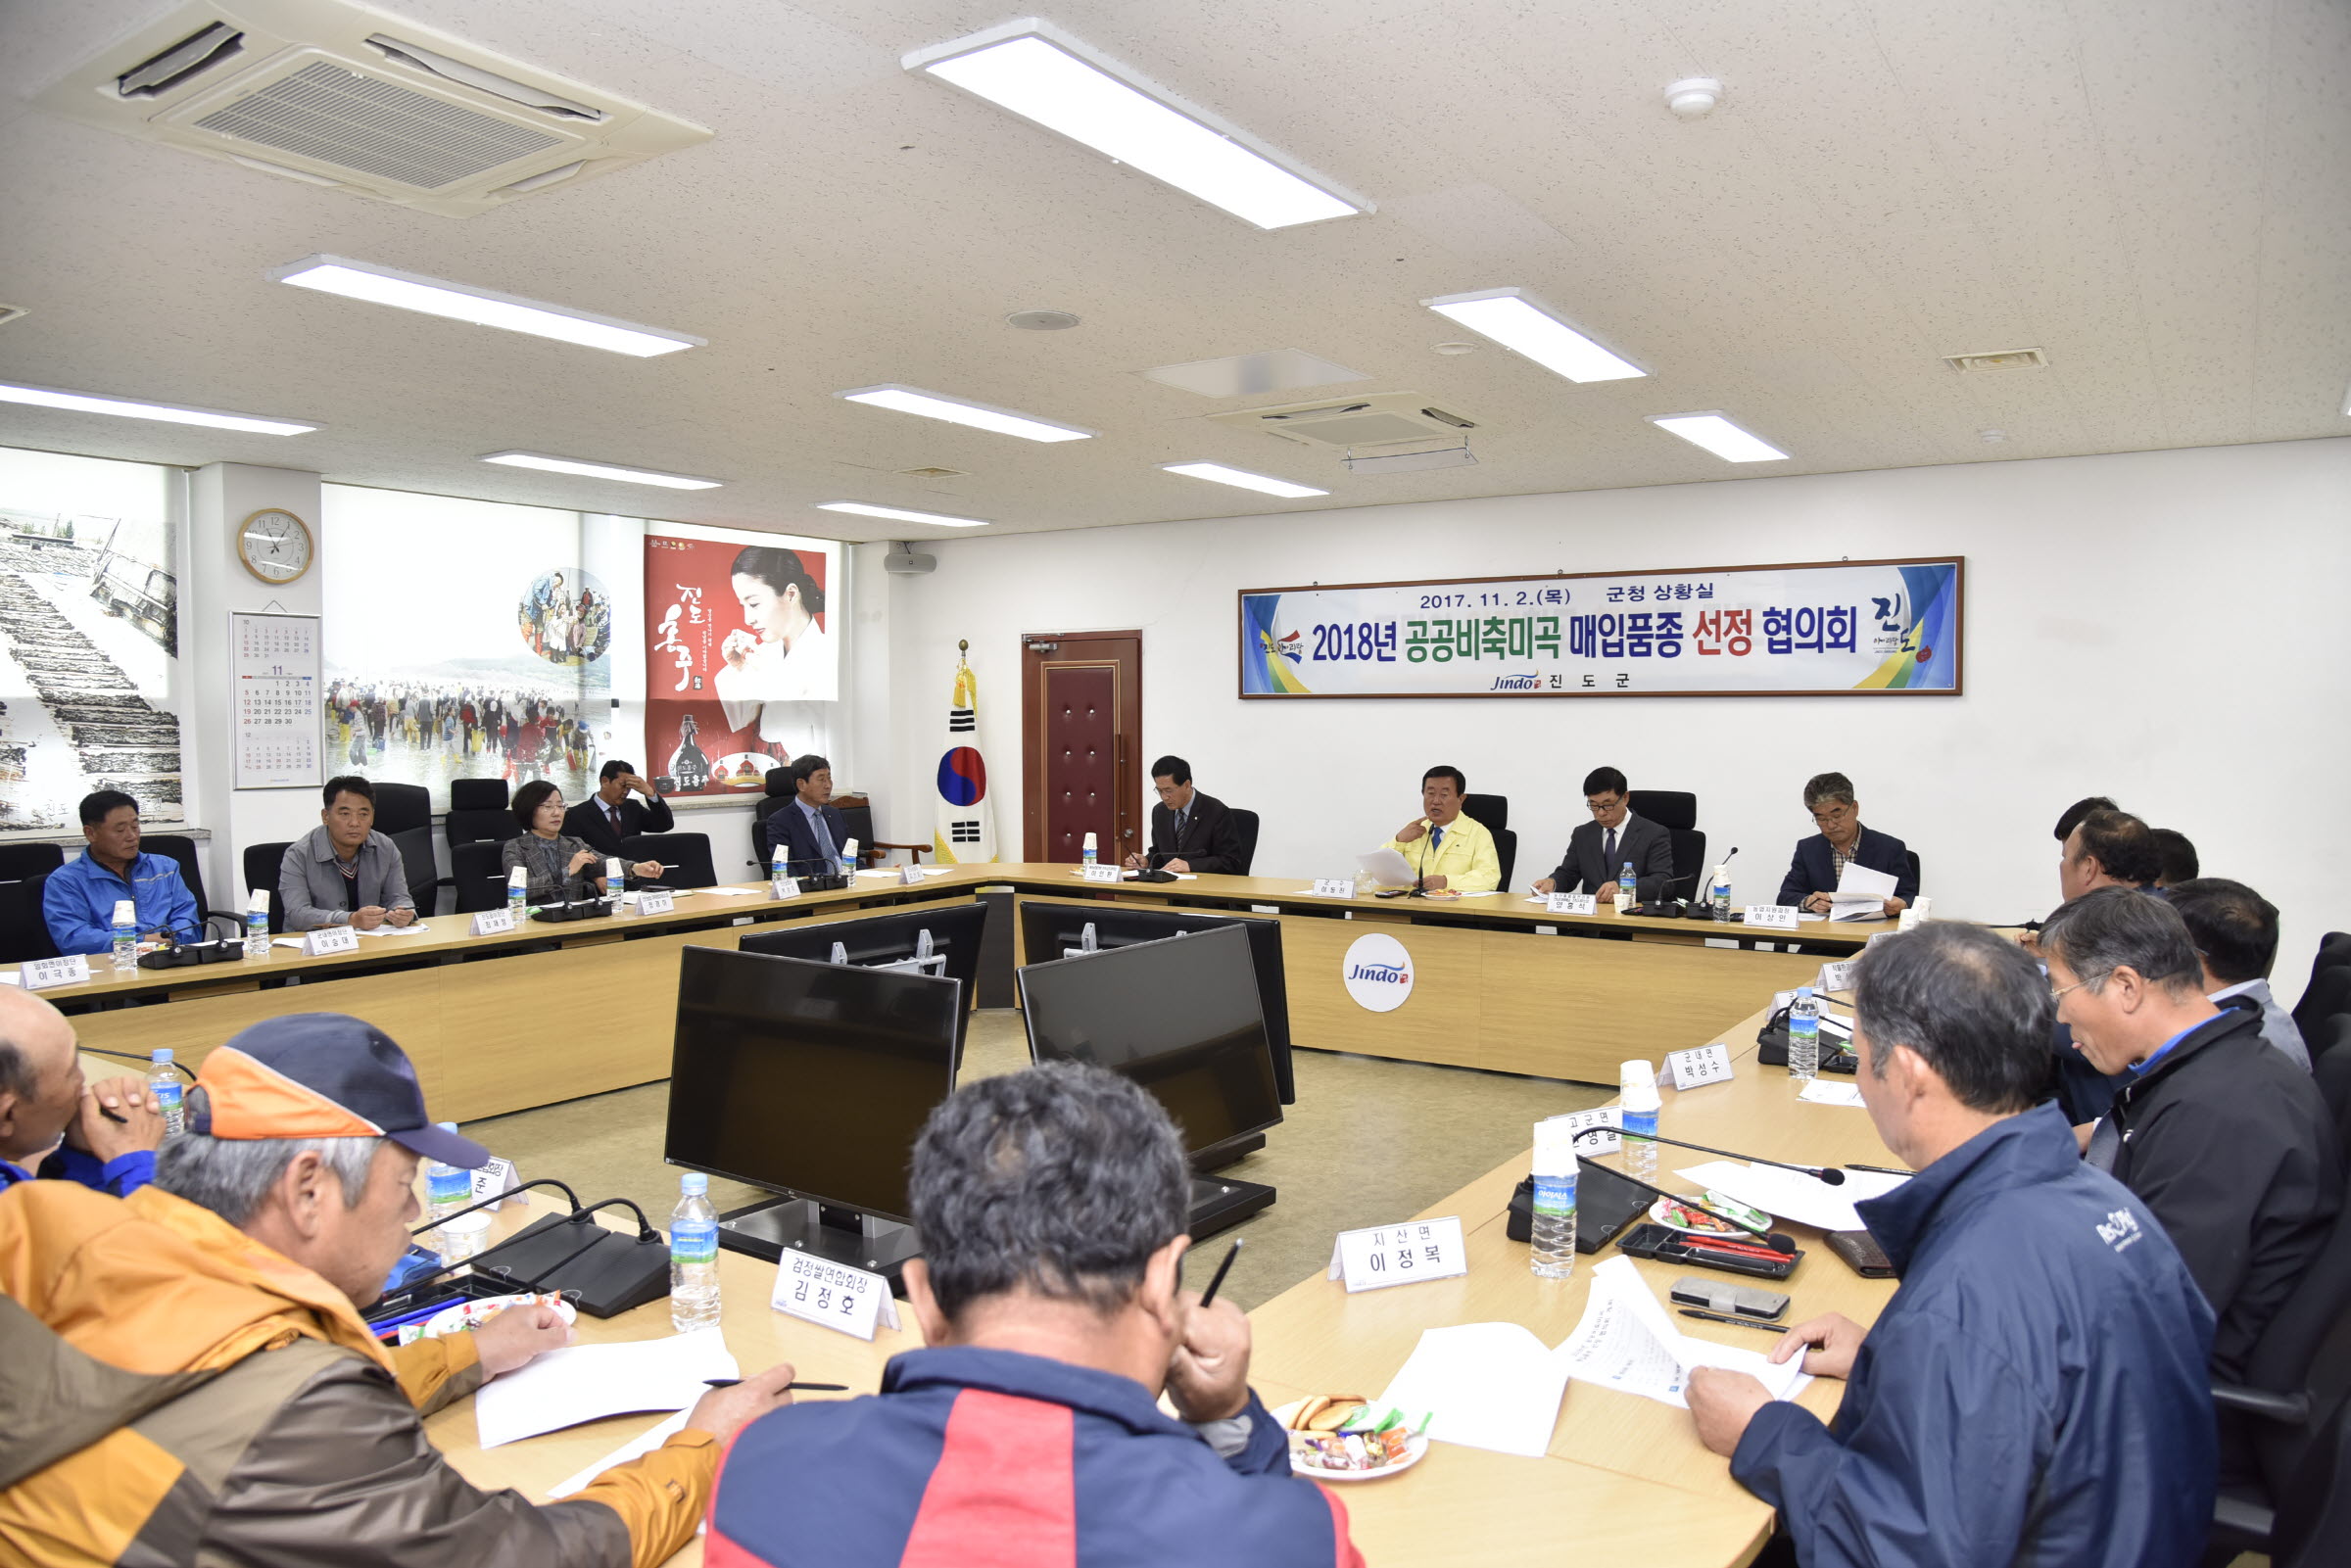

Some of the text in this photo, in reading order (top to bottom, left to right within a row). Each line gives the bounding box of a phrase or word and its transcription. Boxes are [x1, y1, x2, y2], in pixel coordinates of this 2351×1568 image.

[270, 516, 280, 526] 12
[1420, 594, 1471, 608] 2017.
[1480, 593, 1509, 607] 11.
[1607, 582, 1714, 602] 군청 상황실
[1312, 604, 1857, 663] 2018년 공공비축미곡 매입품종 선정 협의회
[272, 665, 283, 676] 11
[1490, 676, 1533, 690] Jindo
[1348, 964, 1398, 983] Jindo
[1684, 1048, 1713, 1063] 군내면
[1685, 1061, 1719, 1077] 박성수
[1568, 1112, 1608, 1127] 고군면
[1374, 1225, 1430, 1247] 지산면
[1370, 1245, 1441, 1271] 이정복
[792, 1258, 868, 1293] 검정쌀연합회장
[794, 1279, 854, 1315] 김정호
